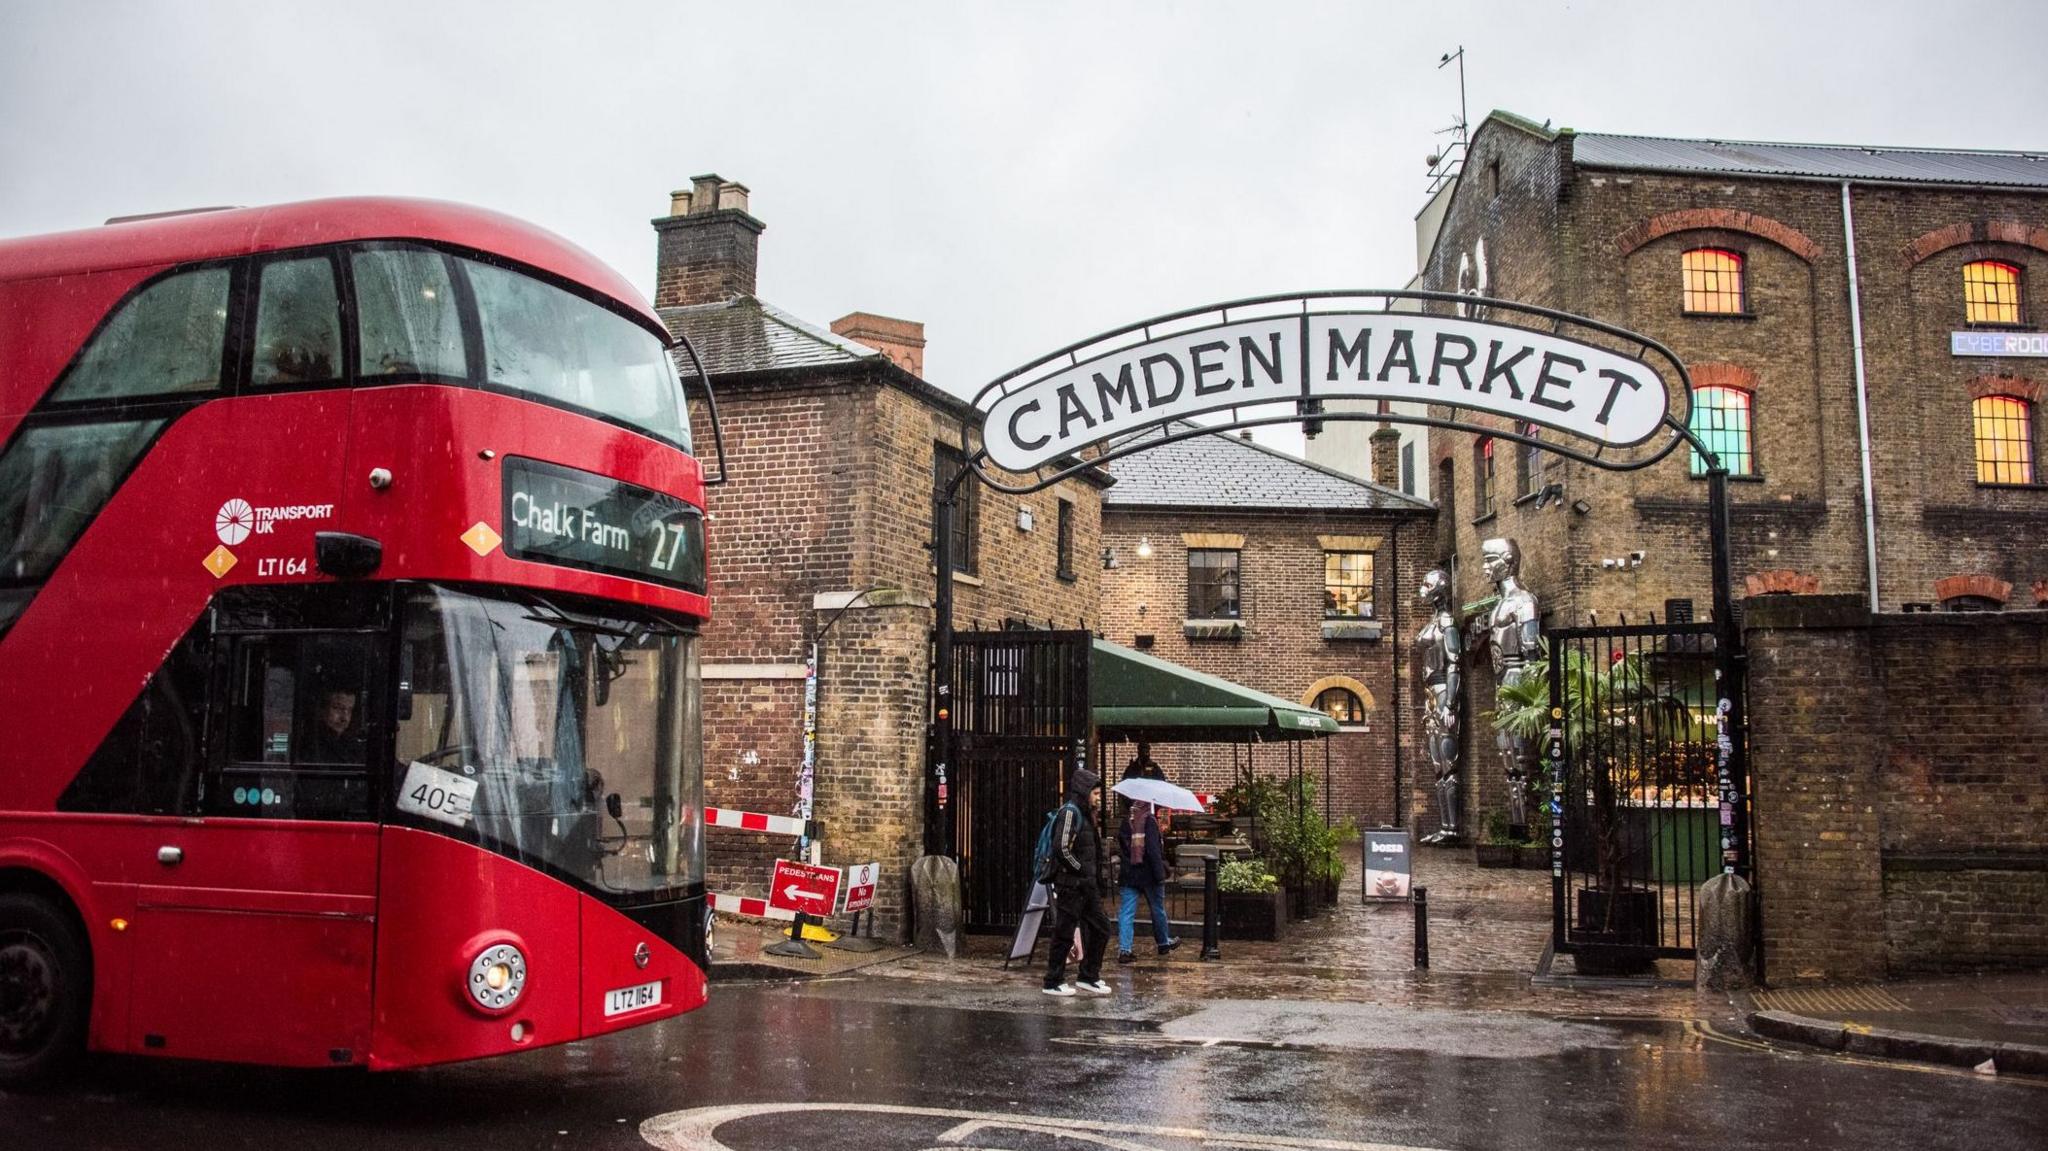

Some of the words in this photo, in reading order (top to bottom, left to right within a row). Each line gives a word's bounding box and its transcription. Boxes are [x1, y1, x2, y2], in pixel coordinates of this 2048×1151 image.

[1008, 332, 1283, 451] CAMDEN
[1327, 327, 1643, 427] MARKET
[254, 504, 334, 521] TRANSPORT
[255, 519, 275, 534] UK
[512, 491, 575, 538] Chalk
[582, 509, 630, 552] Farm
[650, 519, 686, 571] 27
[258, 557, 307, 576] LT164
[410, 783, 464, 816] 405
[779, 867, 835, 882] PEDESTRANS
[858, 887, 867, 897] No
